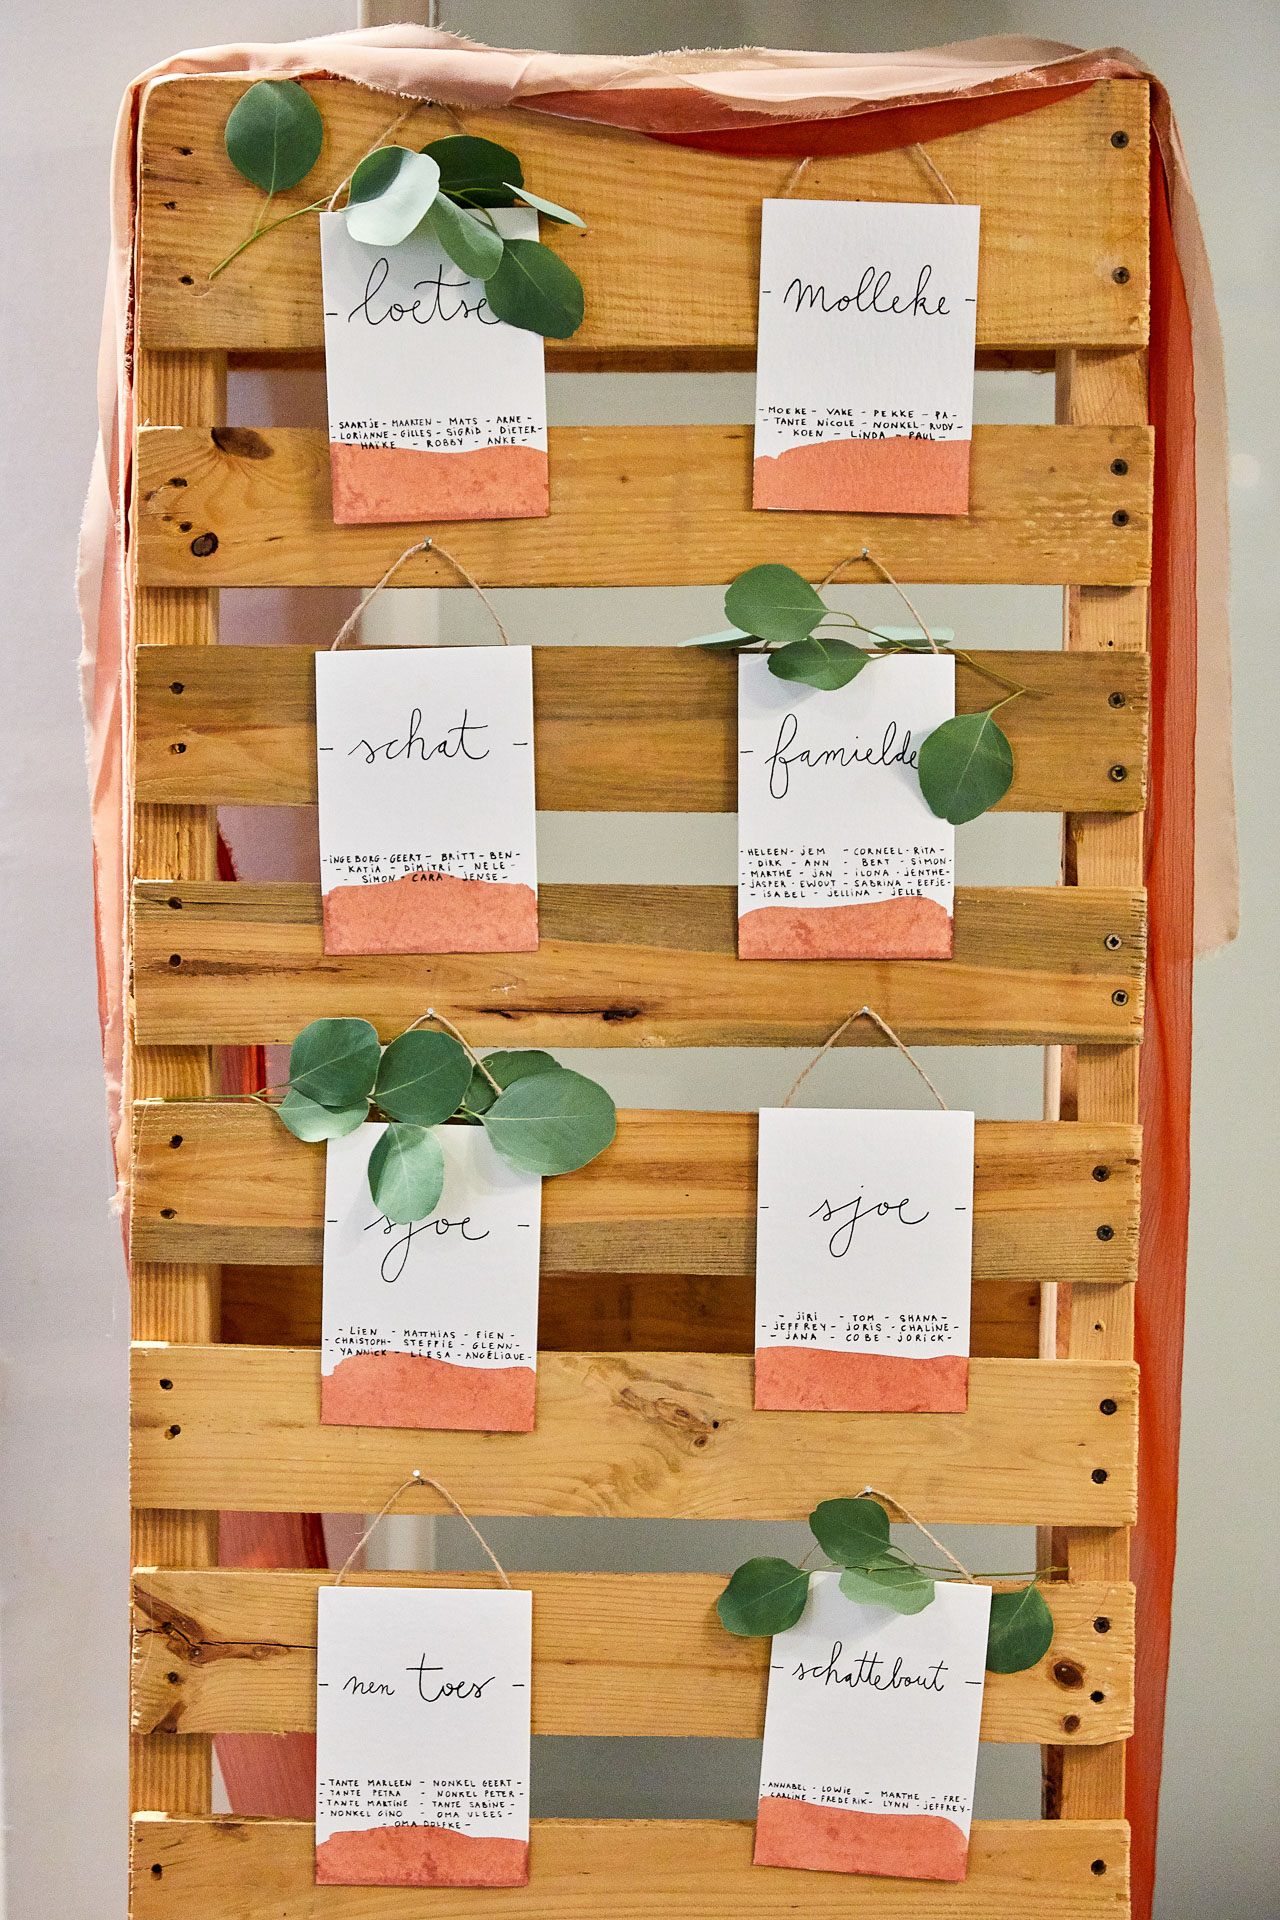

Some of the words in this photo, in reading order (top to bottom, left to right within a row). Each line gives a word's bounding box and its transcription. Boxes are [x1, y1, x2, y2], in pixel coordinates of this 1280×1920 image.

[784, 265, 950, 316] molleke
[769, 407, 806, 415] MOEKE
[874, 410, 913, 418] PEKKE
[935, 411, 948, 419] PA
[392, 419, 431, 427] MAARTEN
[776, 417, 806, 426] TANTE
[794, 429, 823, 437] KOEN
[909, 431, 935, 440] PAUL
[427, 438, 462, 447] ROBBY
[488, 436, 515, 445] ANKE
[348, 708, 489, 764] schat
[390, 854, 421, 864] GEERT
[490, 851, 511, 859] BEN
[748, 848, 787, 856] HELEEN
[475, 862, 505, 870] NELE
[862, 858, 889, 866] BERT
[412, 873, 442, 882] CARA
[800, 880, 835, 888] EWOUT
[809, 1186, 929, 1257] sjoe
[792, 1641, 948, 1691] schattebout
[343, 1676, 395, 1695] nen
[406, 1653, 495, 1702] toes
[329, 1779, 359, 1787] TANTE
[769, 1782, 806, 1791] ANNABEL
[881, 1791, 919, 1800] MARTHE
[328, 1799, 359, 1807] TANTE
